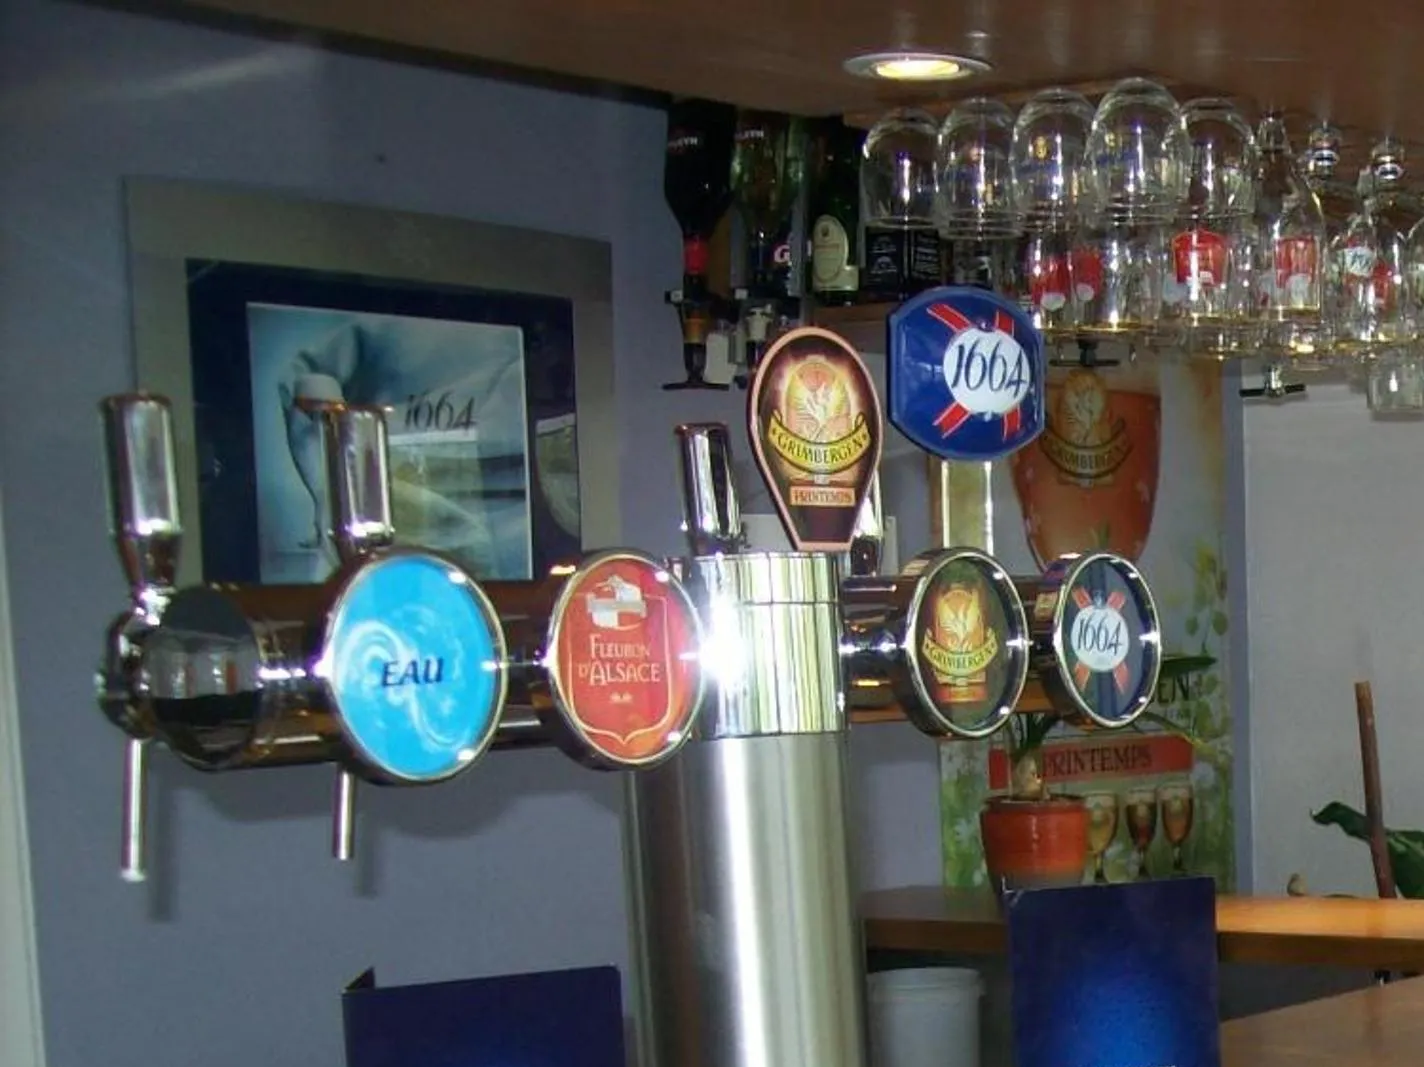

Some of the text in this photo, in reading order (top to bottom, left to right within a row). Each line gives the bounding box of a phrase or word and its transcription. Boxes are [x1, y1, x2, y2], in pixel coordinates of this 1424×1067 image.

[951, 337, 1027, 399] 1664
[404, 388, 478, 431] 1664
[777, 433, 863, 464] GRIMBERGEN
[1078, 611, 1123, 656] 1664
[382, 656, 444, 687] EAU
